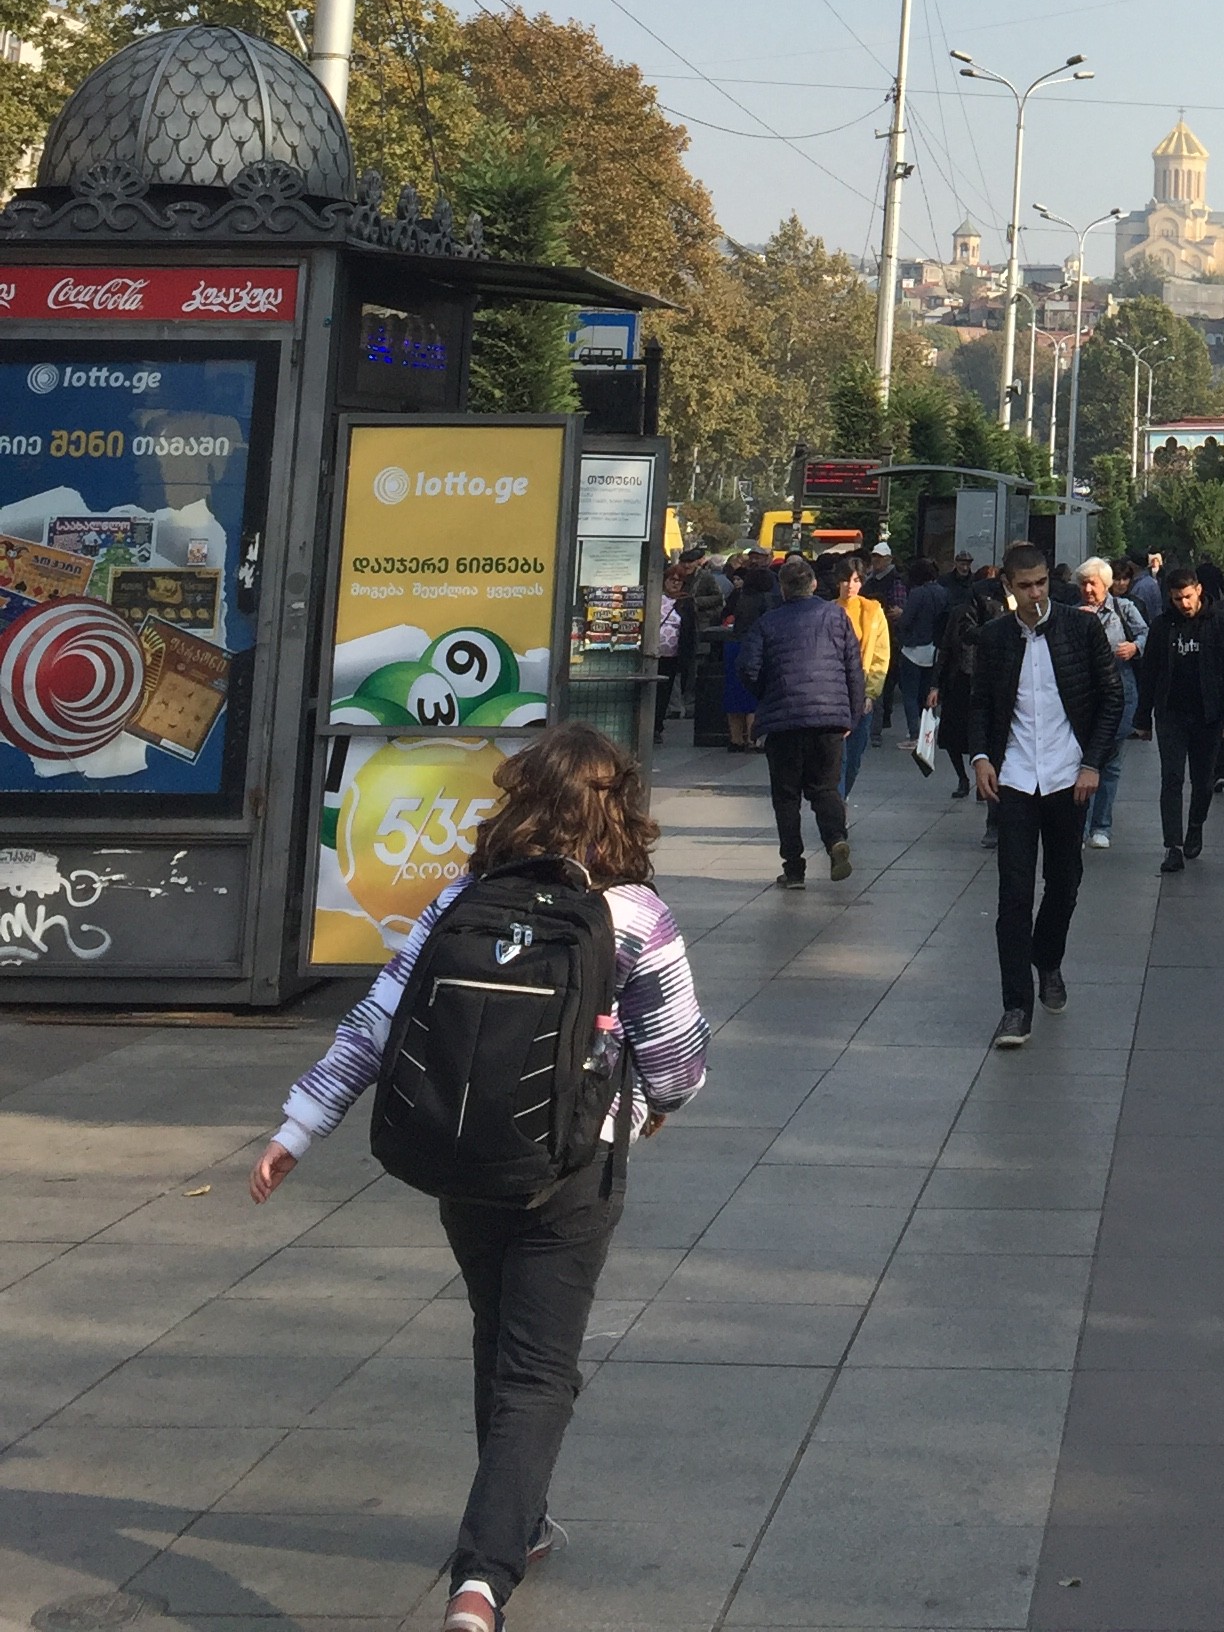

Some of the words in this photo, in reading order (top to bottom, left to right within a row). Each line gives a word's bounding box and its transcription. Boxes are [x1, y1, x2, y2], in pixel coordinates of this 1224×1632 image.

[48, 277, 150, 311] Coca-Cola
[63, 366, 162, 394] lotto.ge
[50, 430, 125, 458] შენი
[132, 435, 230, 457] თამაში
[414, 471, 529, 504] lotto.ge
[353, 556, 449, 574] დაუჯერე
[455, 556, 545, 574] ნიშნებს
[351, 582, 404, 599] მოგება
[412, 582, 479, 599] შეუძლია
[486, 582, 544, 599] ყველას
